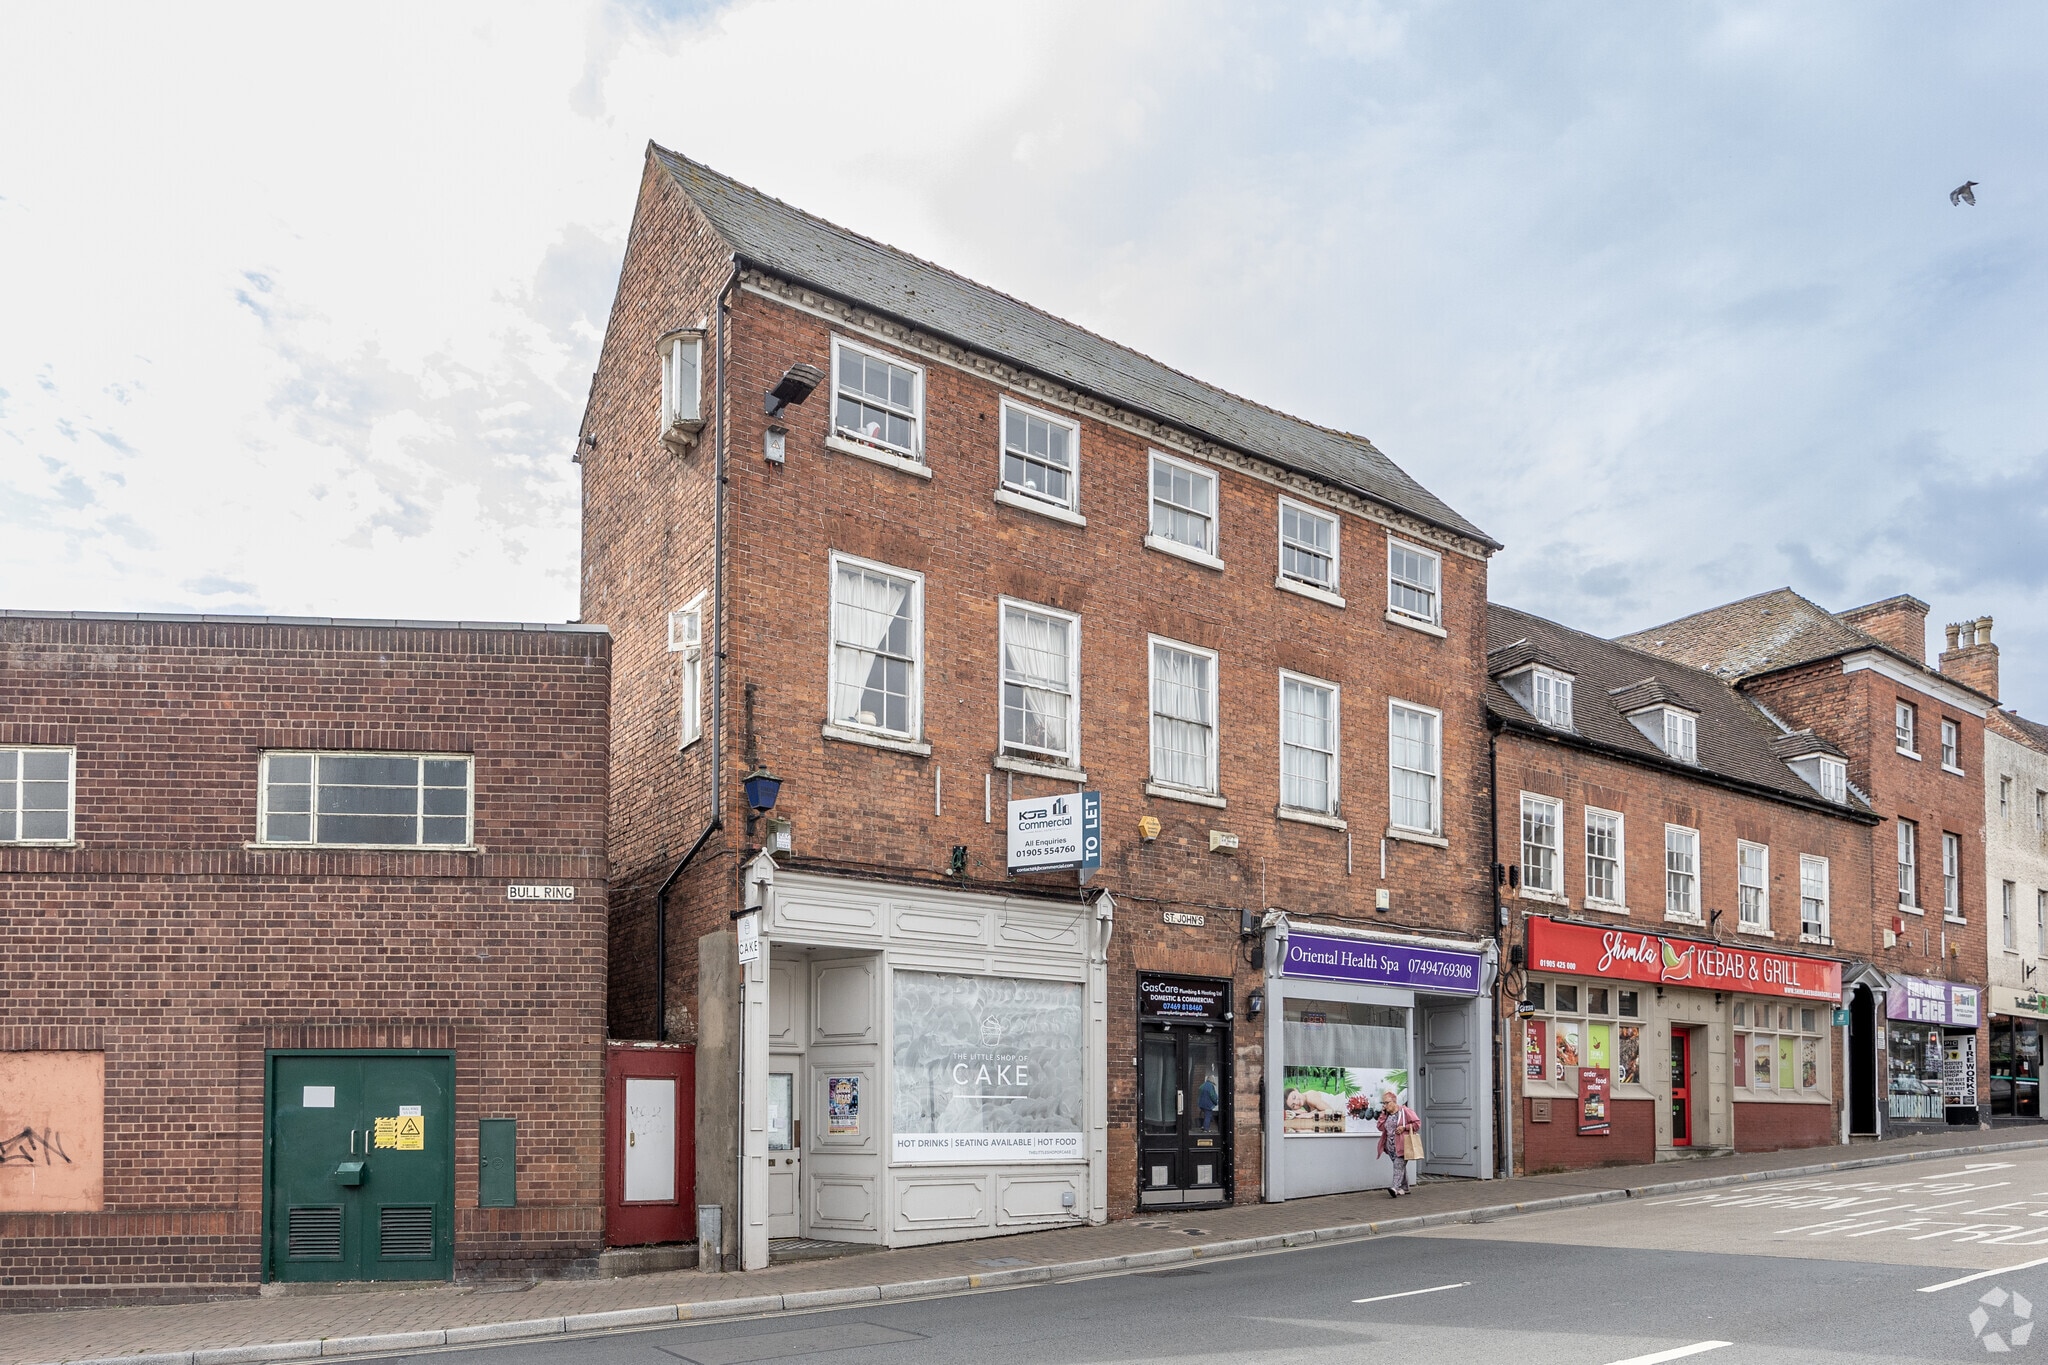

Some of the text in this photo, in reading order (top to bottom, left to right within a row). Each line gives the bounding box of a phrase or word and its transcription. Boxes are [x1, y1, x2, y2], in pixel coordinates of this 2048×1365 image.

[1019, 809, 1047, 820] KJB
[1018, 816, 1072, 831] Commercial
[1085, 798, 1098, 861] TO LET
[1035, 837, 1067, 846] Enquiries
[1016, 845, 1076, 857] 01905 554760
[510, 887, 572, 898] BULL RING
[1165, 913, 1176, 922] ST.
[740, 940, 758, 955] CAKE
[1290, 946, 1472, 979] Oriental Health Spa 07494769308
[1539, 959, 1555, 968] 01905
[1556, 960, 1566, 969] 425
[1597, 931, 1801, 986] Shimla KEBAB & GRILL
[1141, 981, 1179, 994] GasCare
[1150, 994, 1176, 1002] DOMESTIC
[1182, 996, 1214, 1004] COMMERCIAL
[953, 1052, 967, 1060] THE
[970, 1053, 994, 1061] LITTLE
[1966, 1036, 1975, 1096] FIREWORKS
[952, 1063, 1028, 1086] CAKE
[1583, 1070, 1597, 1078] order
[1595, 1077, 1607, 1085] food
[1587, 1083, 1602, 1091] online
[897, 1138, 1077, 1148] HOT DRINKS SEATING AVAILABLE HOT FOOD
